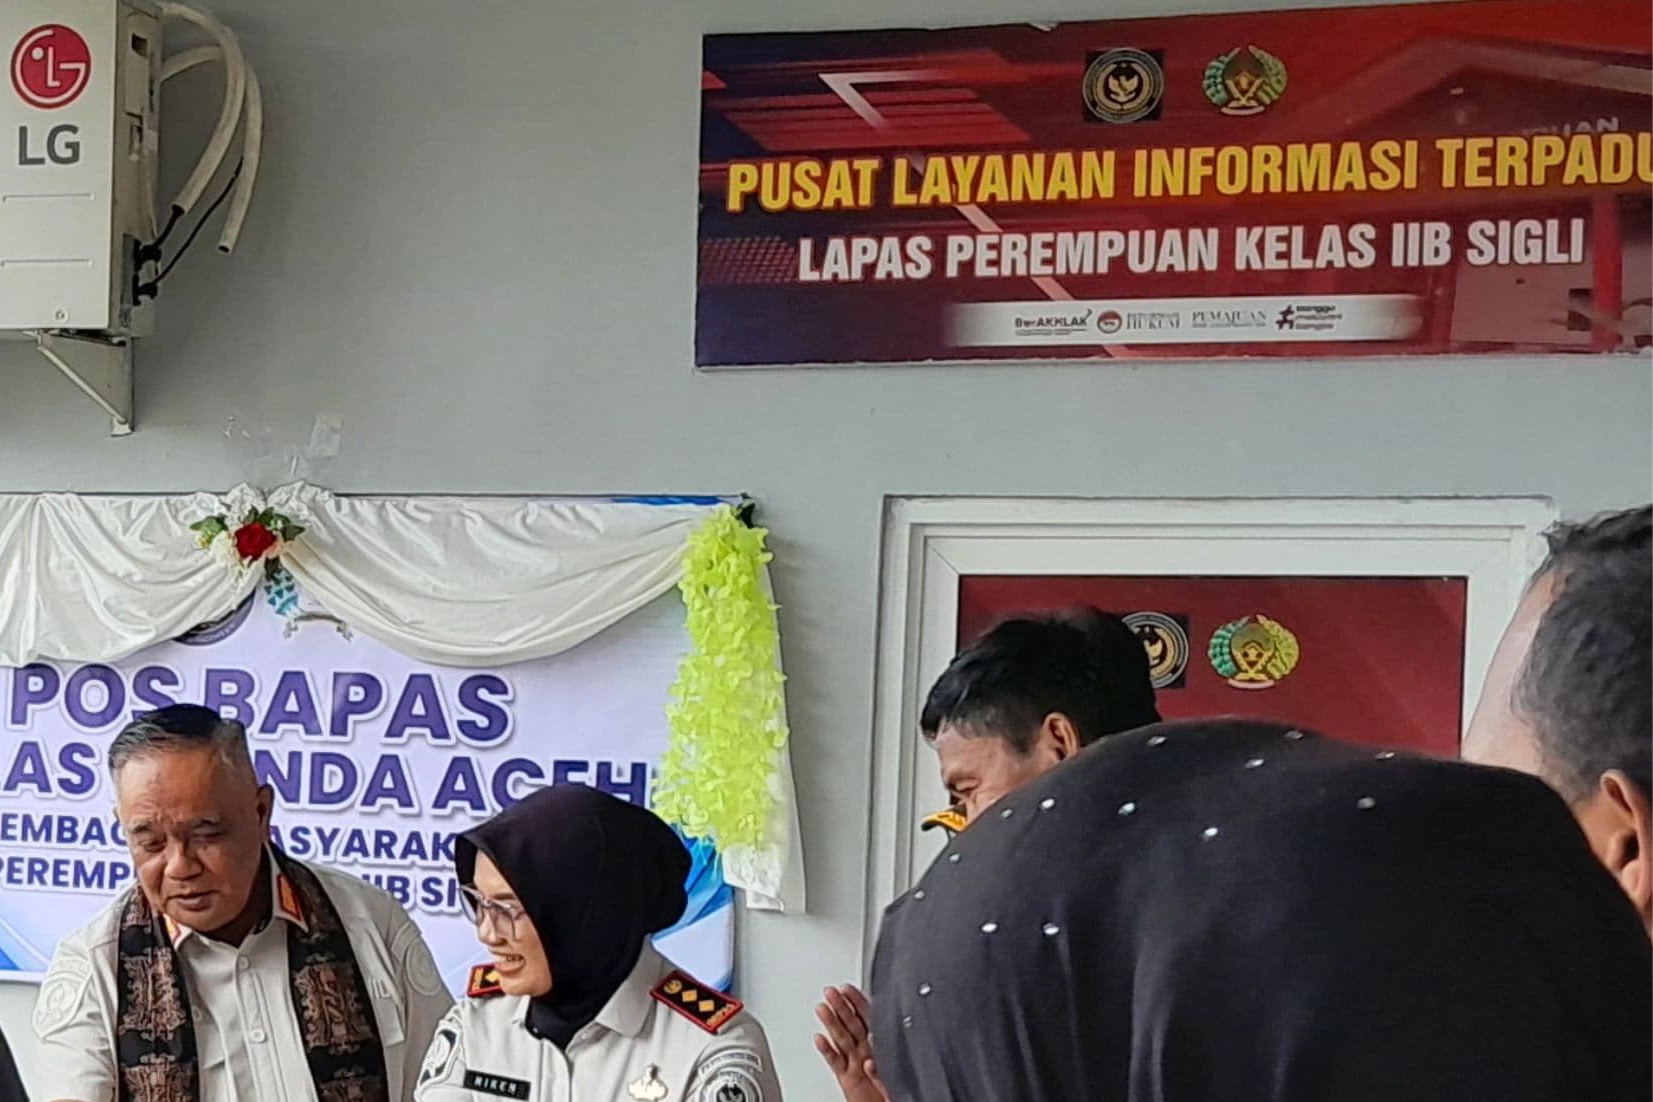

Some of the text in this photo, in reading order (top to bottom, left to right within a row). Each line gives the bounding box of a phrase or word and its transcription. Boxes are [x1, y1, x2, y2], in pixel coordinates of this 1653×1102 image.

[19, 124, 80, 165] LG
[727, 157, 875, 211] PUSAT
[892, 150, 1116, 206] LAYANAN
[1133, 141, 1419, 198] INFORMASI
[798, 219, 1584, 282] LAPAS PEREMPUAN KELAS IIB SIGLI
[10, 662, 510, 742] POS BAPAS
[254, 749, 414, 808] NDA
